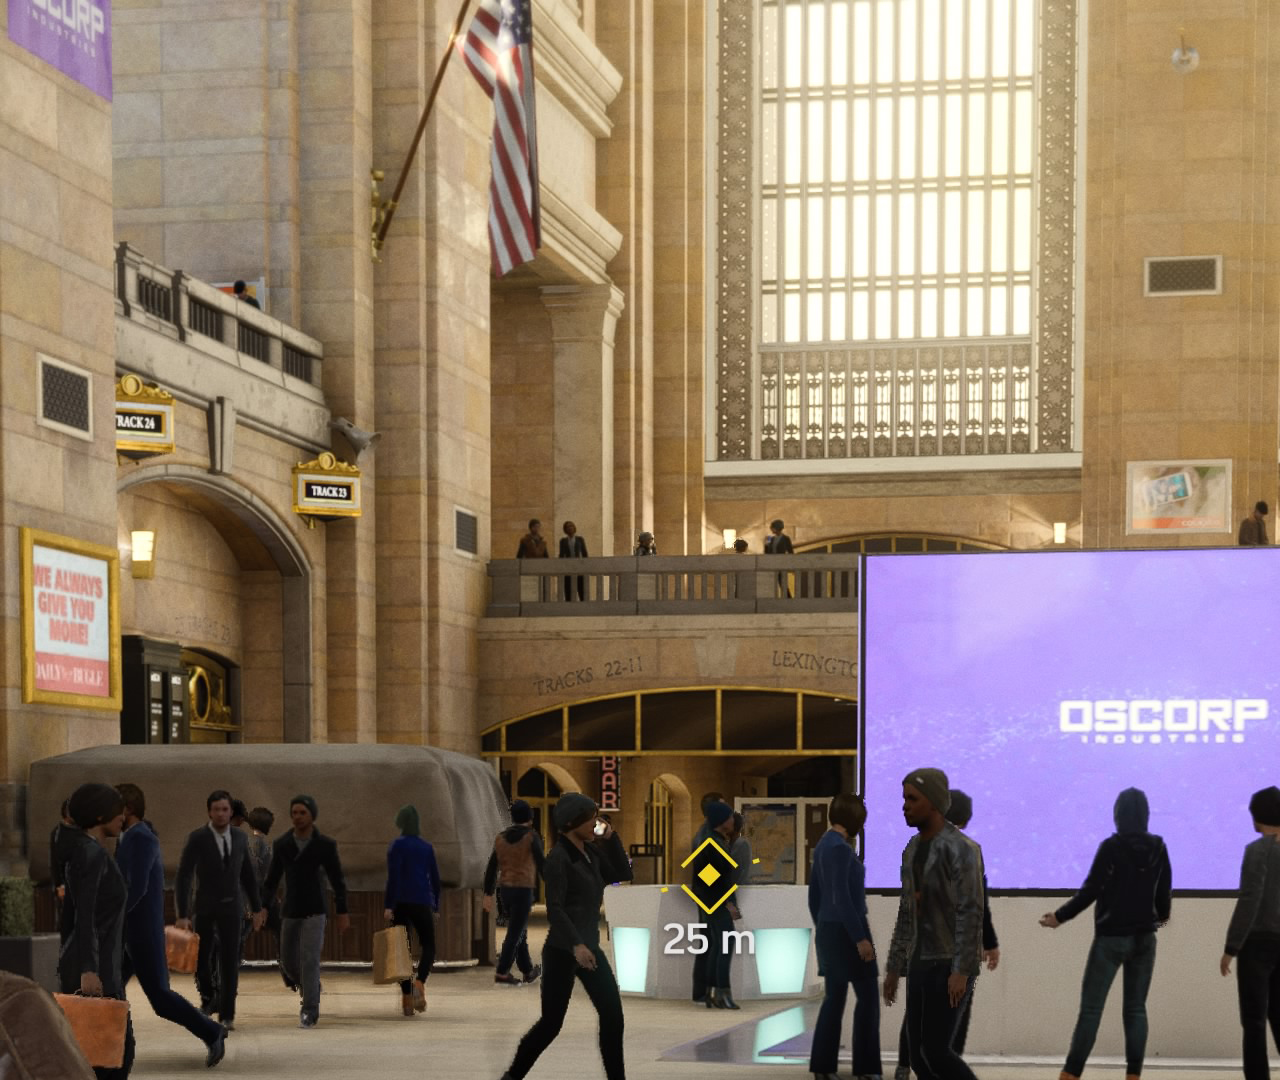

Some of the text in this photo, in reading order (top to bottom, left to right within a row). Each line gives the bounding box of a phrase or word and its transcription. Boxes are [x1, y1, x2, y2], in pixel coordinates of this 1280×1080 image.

[144, 417, 156, 430] 24
[311, 485, 348, 499] TRACK 23
[34, 564, 103, 599] WE ALWAYS
[38, 591, 95, 622] GIVE YOU
[49, 618, 89, 646] MORE!
[73, 667, 104, 687] BUGLE
[533, 656, 642, 696] TRACKS 22-11
[1059, 699, 1269, 733] OSCORP
[1081, 733, 1245, 745] INDUSTRIES
[602, 753, 617, 809] BAR
